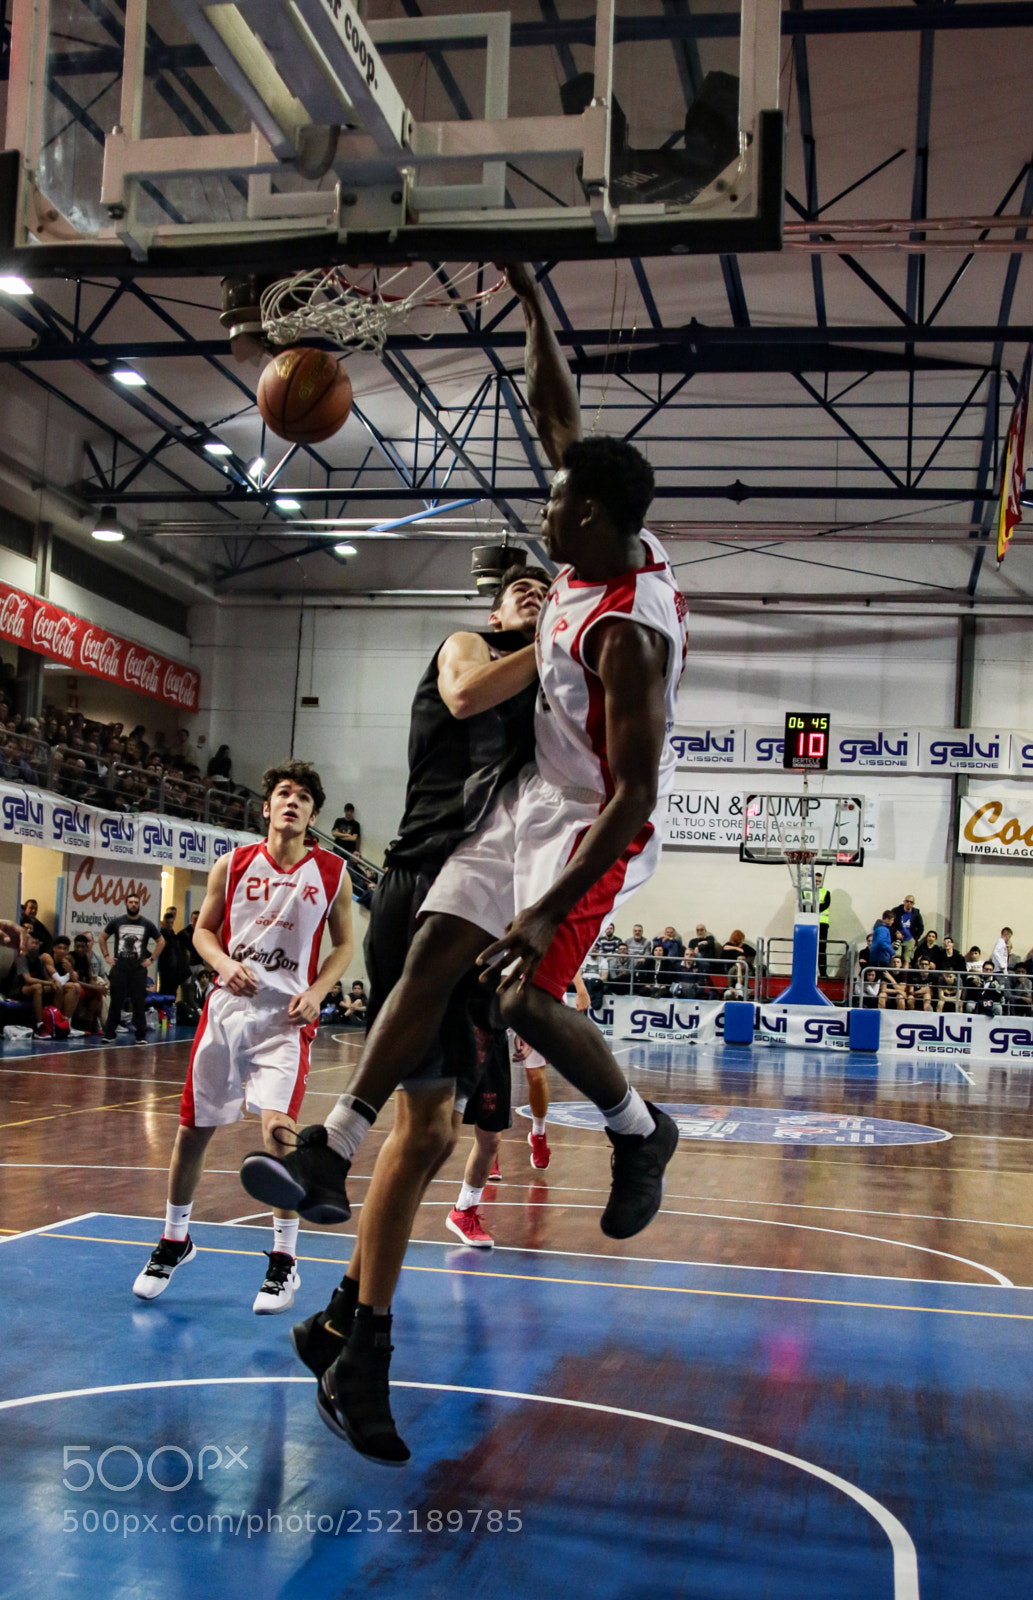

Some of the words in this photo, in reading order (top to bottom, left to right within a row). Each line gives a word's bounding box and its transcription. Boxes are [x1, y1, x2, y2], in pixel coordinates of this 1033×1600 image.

[345, 12, 378, 91] coop.
[0, 593, 28, 639] Cola
[788, 716, 805, 729] 06
[811, 717, 828, 730] 45
[669, 730, 735, 759] galvi
[799, 732, 825, 758] 10
[839, 732, 908, 763] galvi
[930, 734, 999, 765] galvi
[686, 755, 735, 763] LISSONE
[858, 759, 908, 767] LISSONE
[3, 789, 44, 831] galvi
[667, 794, 720, 815] RUN
[728, 796, 743, 816] &
[753, 797, 821, 817] JUMP
[14, 826, 44, 840] LISSONE
[52, 803, 91, 840] galvi
[100, 814, 134, 848] galvi
[672, 817, 681, 826] IL
[684, 817, 706, 828] TUO
[709, 818, 743, 829] STORE
[748, 820, 767, 829] DEL
[771, 820, 815, 829] BASKT
[63, 836, 90, 848] LISSONE
[143, 818, 173, 854] galvi
[179, 826, 206, 859] galvi
[669, 830, 716, 841] LISSONE
[725, 832, 743, 841] VIA
[803, 834, 815, 844] 20
[110, 844, 134, 855] LISSONE
[73, 856, 151, 907] Cocoon
[246, 876, 270, 901] 21
[71, 910, 102, 927] Packaging
[630, 1003, 699, 1034] galvi
[647, 1031, 699, 1040] LISSONE
[754, 1034, 787, 1043] SONE
[896, 1015, 972, 1049] galvi
[916, 1045, 972, 1054] LISSONE
